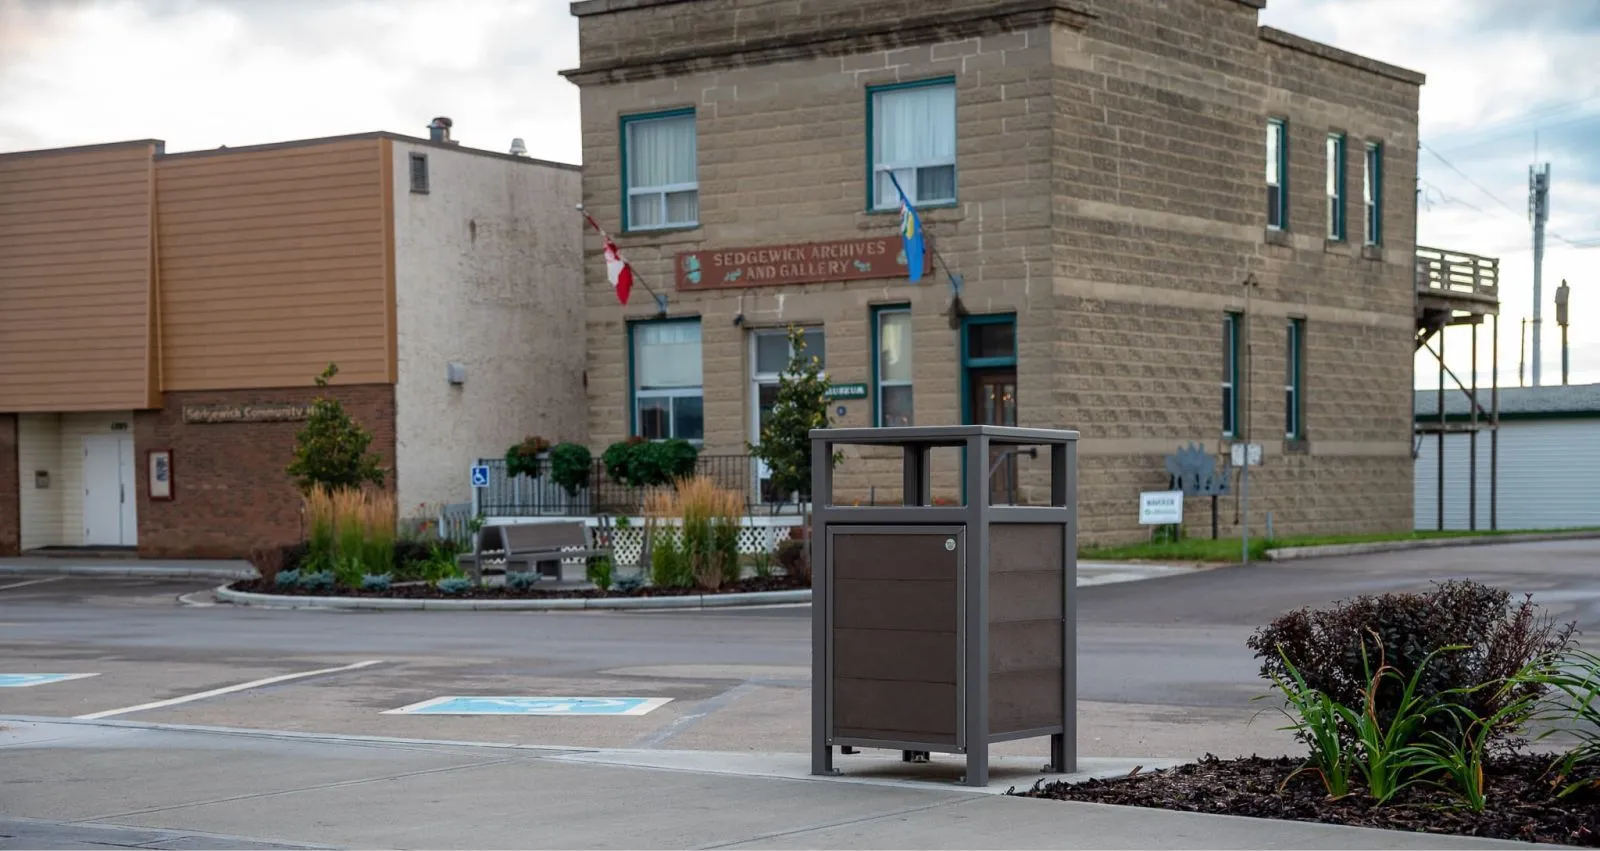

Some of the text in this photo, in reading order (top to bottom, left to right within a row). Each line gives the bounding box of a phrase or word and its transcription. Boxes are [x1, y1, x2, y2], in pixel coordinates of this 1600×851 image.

[713, 240, 886, 266] SEDGEWICK ARCHIVES
[746, 259, 850, 281] AND GALLERY
[244, 405, 304, 420] Community
